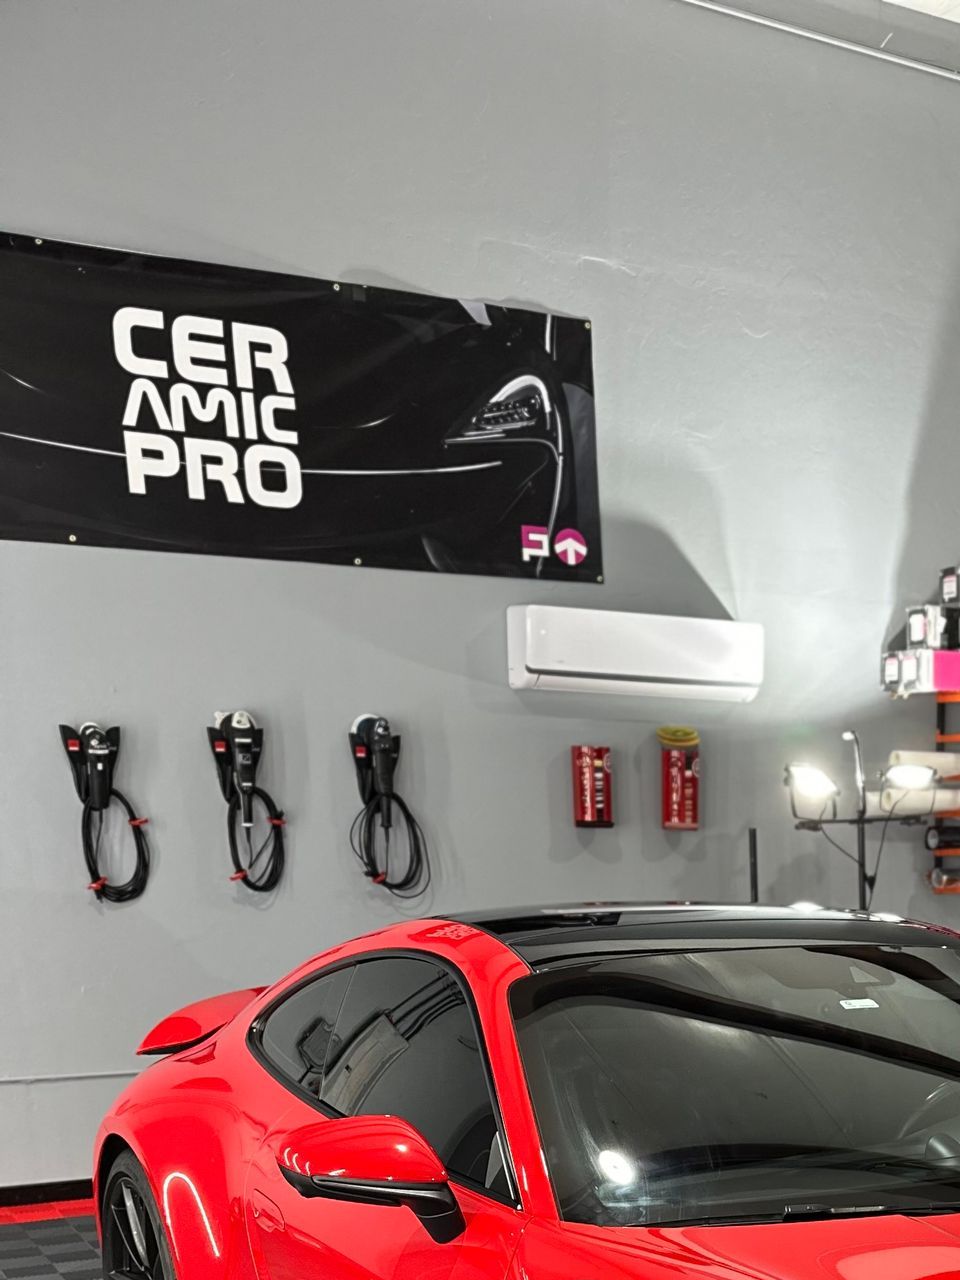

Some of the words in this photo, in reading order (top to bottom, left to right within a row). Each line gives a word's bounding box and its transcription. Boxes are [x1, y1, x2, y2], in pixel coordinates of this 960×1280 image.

[112, 306, 295, 395] CER
[121, 377, 299, 445] AMIC
[122, 430, 303, 509] PRO
